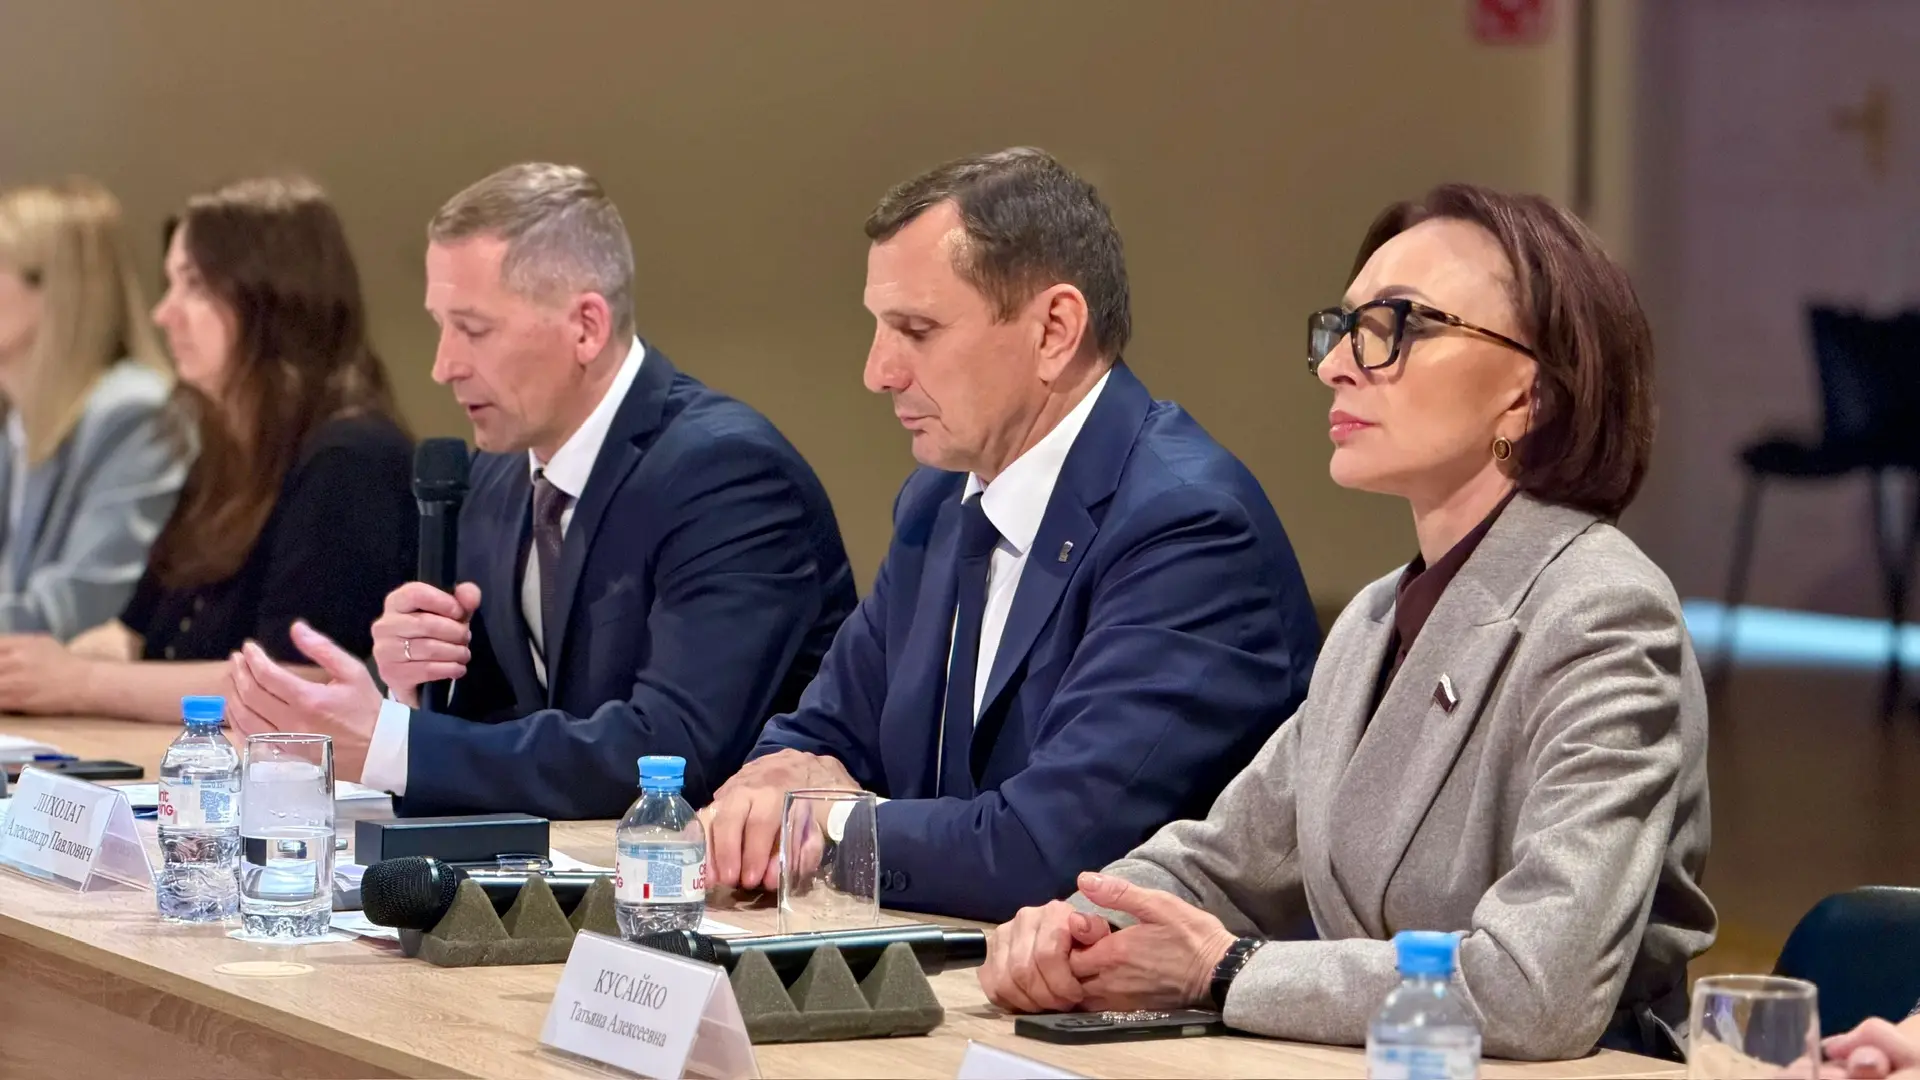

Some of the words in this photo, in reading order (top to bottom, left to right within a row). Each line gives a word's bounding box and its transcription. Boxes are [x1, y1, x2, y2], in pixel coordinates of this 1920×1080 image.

[33, 792, 86, 824] ЛИХОЛАТ
[5, 817, 50, 852] Александр
[48, 830, 93, 862] Павлович
[593, 969, 668, 1010] КУСАЙКО
[570, 1000, 608, 1029] Татьяна
[606, 1012, 667, 1048] Алексеевна
